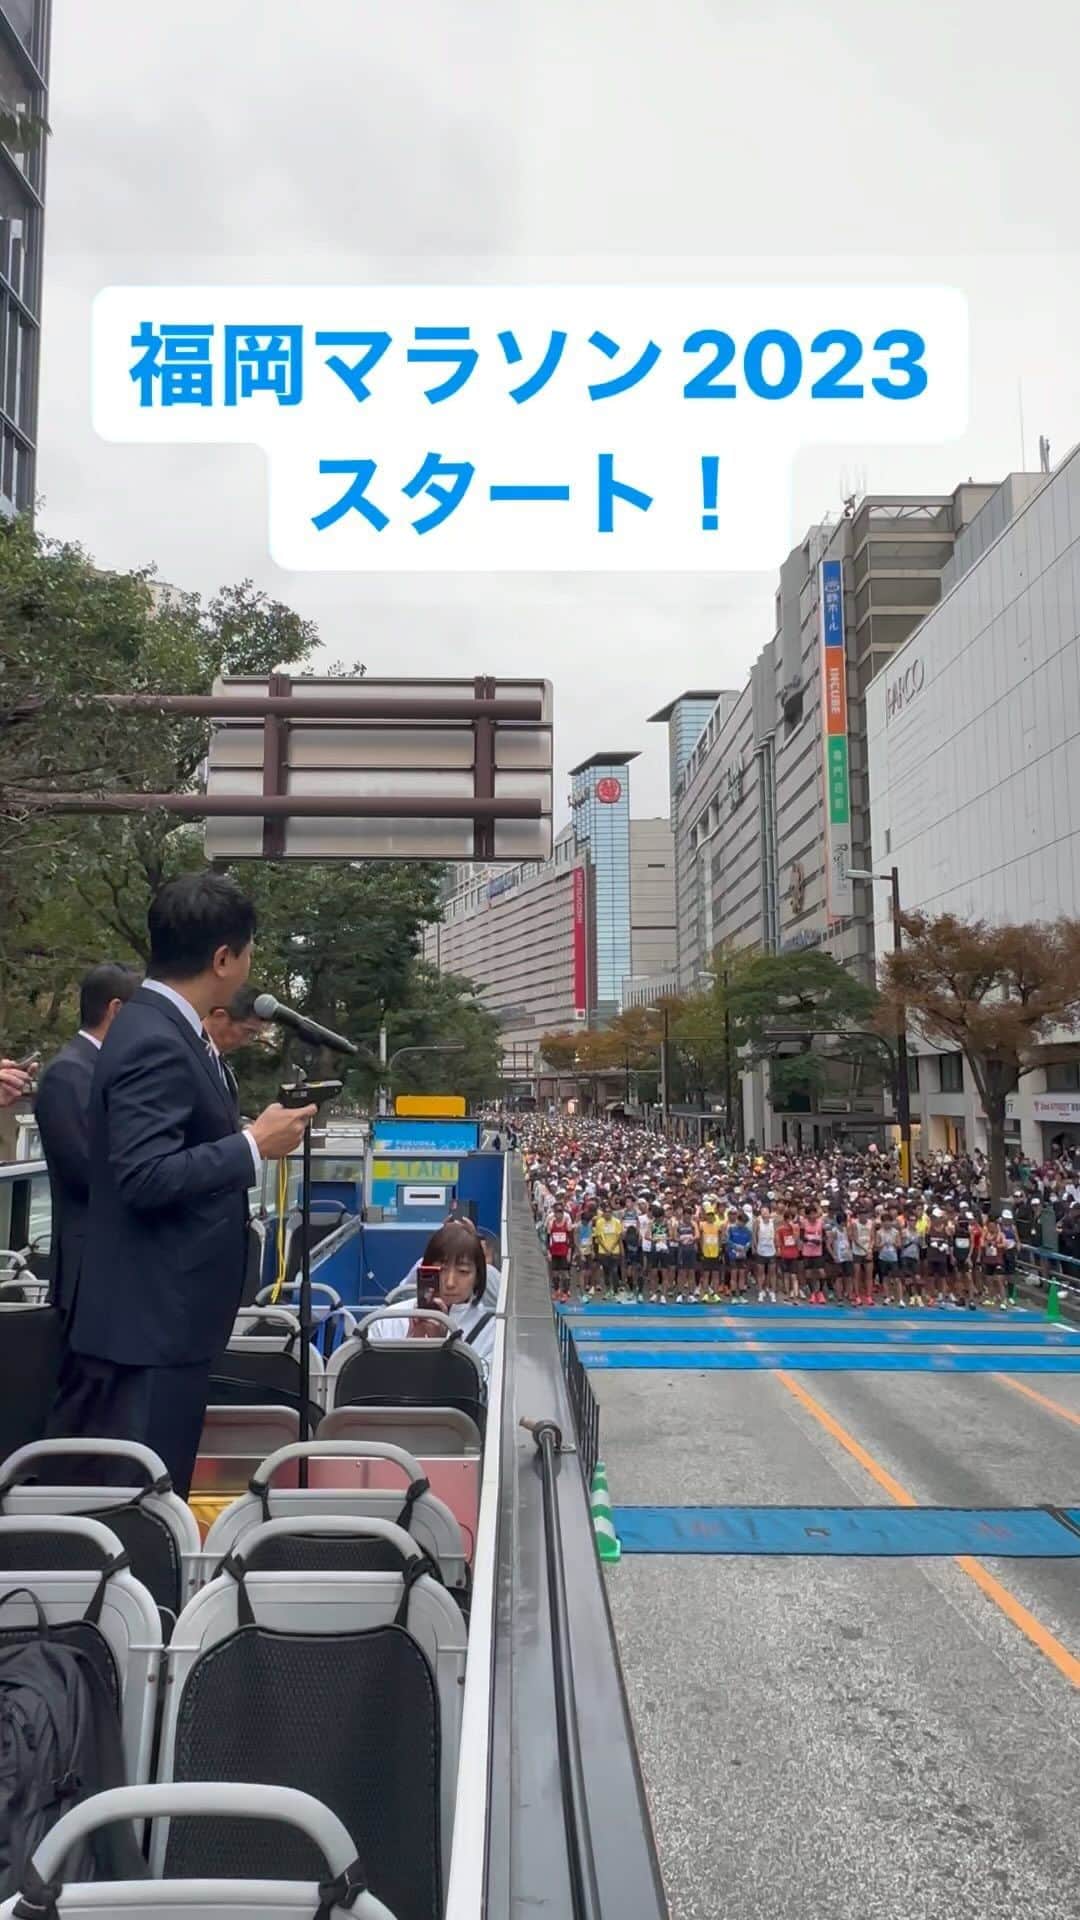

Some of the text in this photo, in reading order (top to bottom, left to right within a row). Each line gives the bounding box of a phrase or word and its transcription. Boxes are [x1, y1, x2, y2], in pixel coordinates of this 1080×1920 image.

[830, 667, 841, 713] INCUBE
[887, 659, 925, 719] PARCO
[391, 1161, 456, 1178] START
